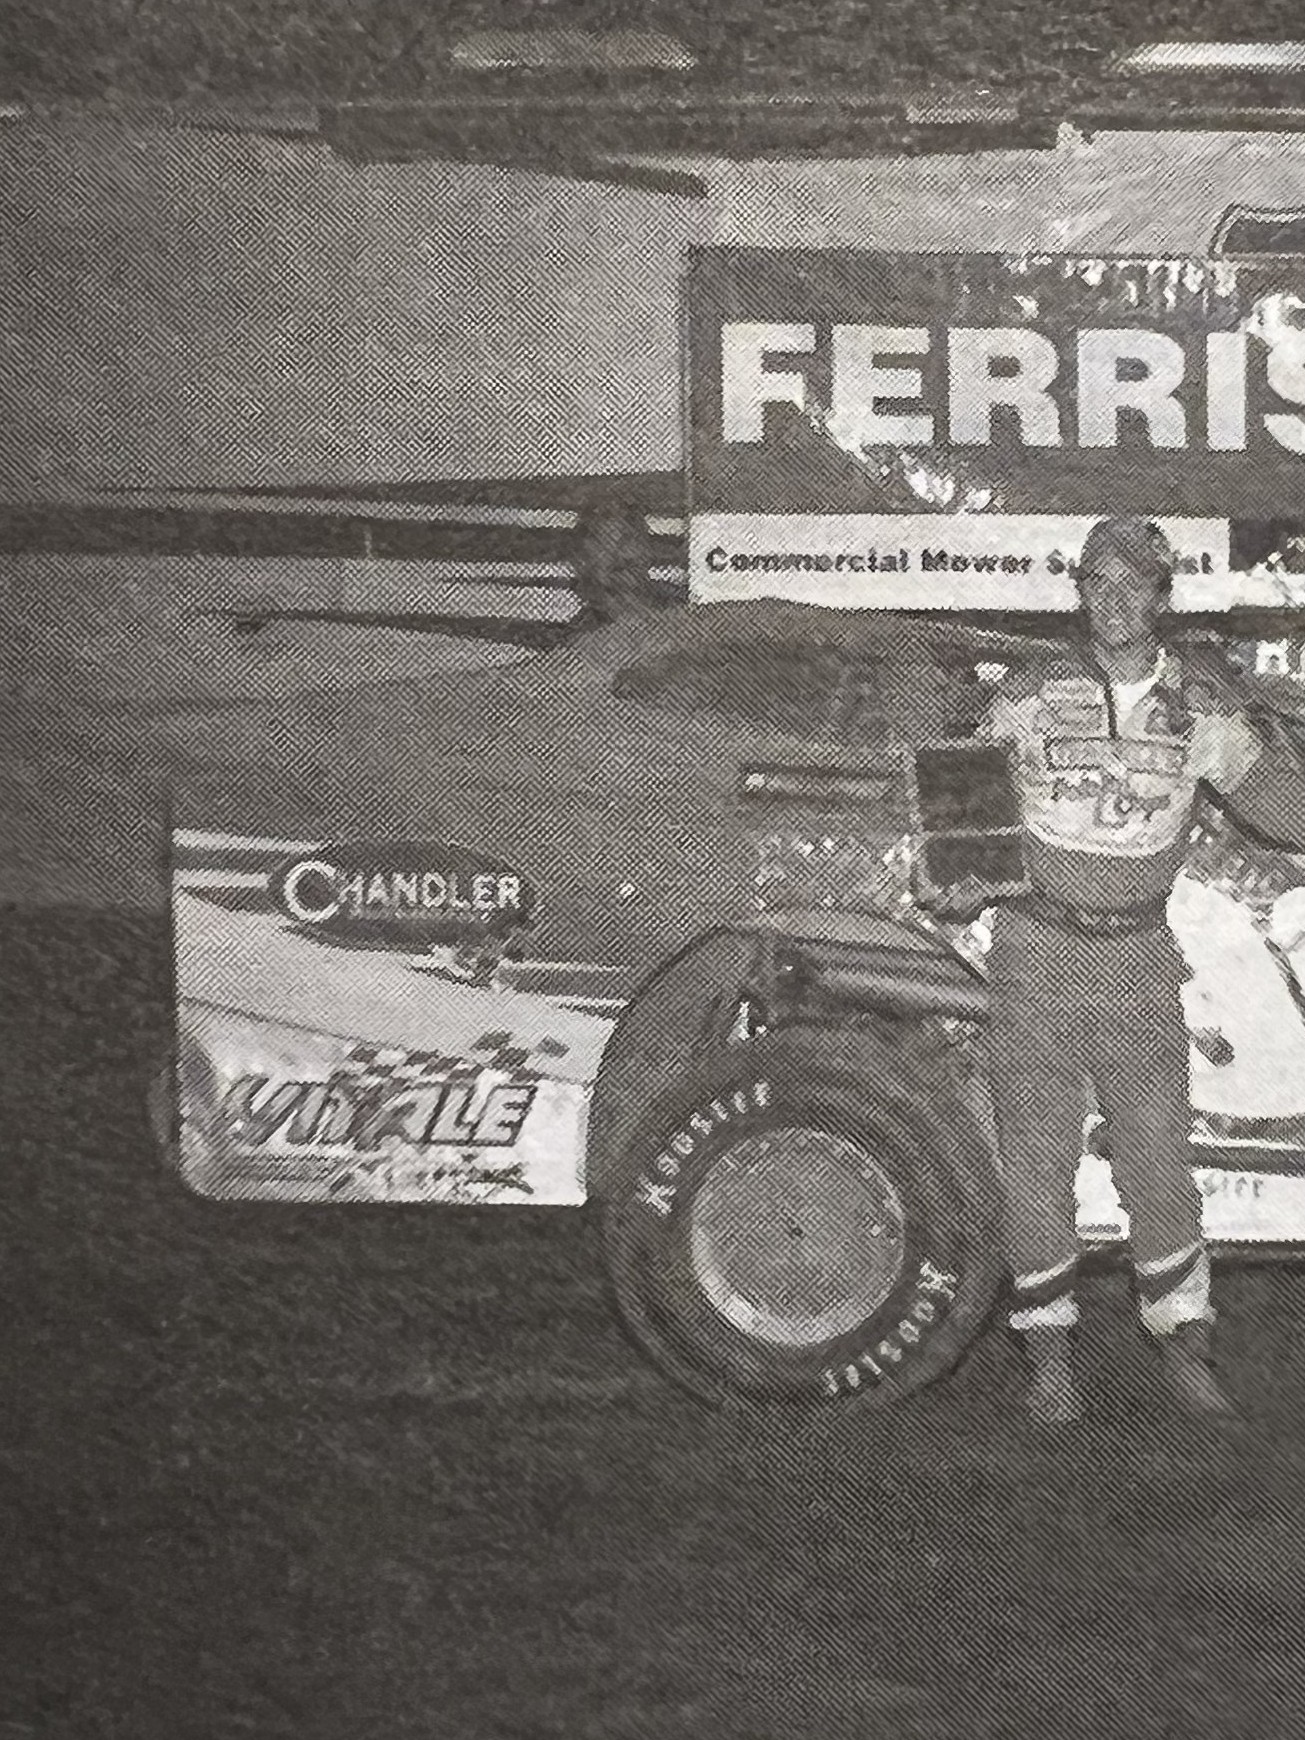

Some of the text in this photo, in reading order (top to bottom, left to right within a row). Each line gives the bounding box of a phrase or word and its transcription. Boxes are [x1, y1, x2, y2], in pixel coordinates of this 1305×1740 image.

[704, 546, 908, 574] Commercial
[919, 547, 1032, 575] Mower
[283, 859, 522, 922] CHANDLER
